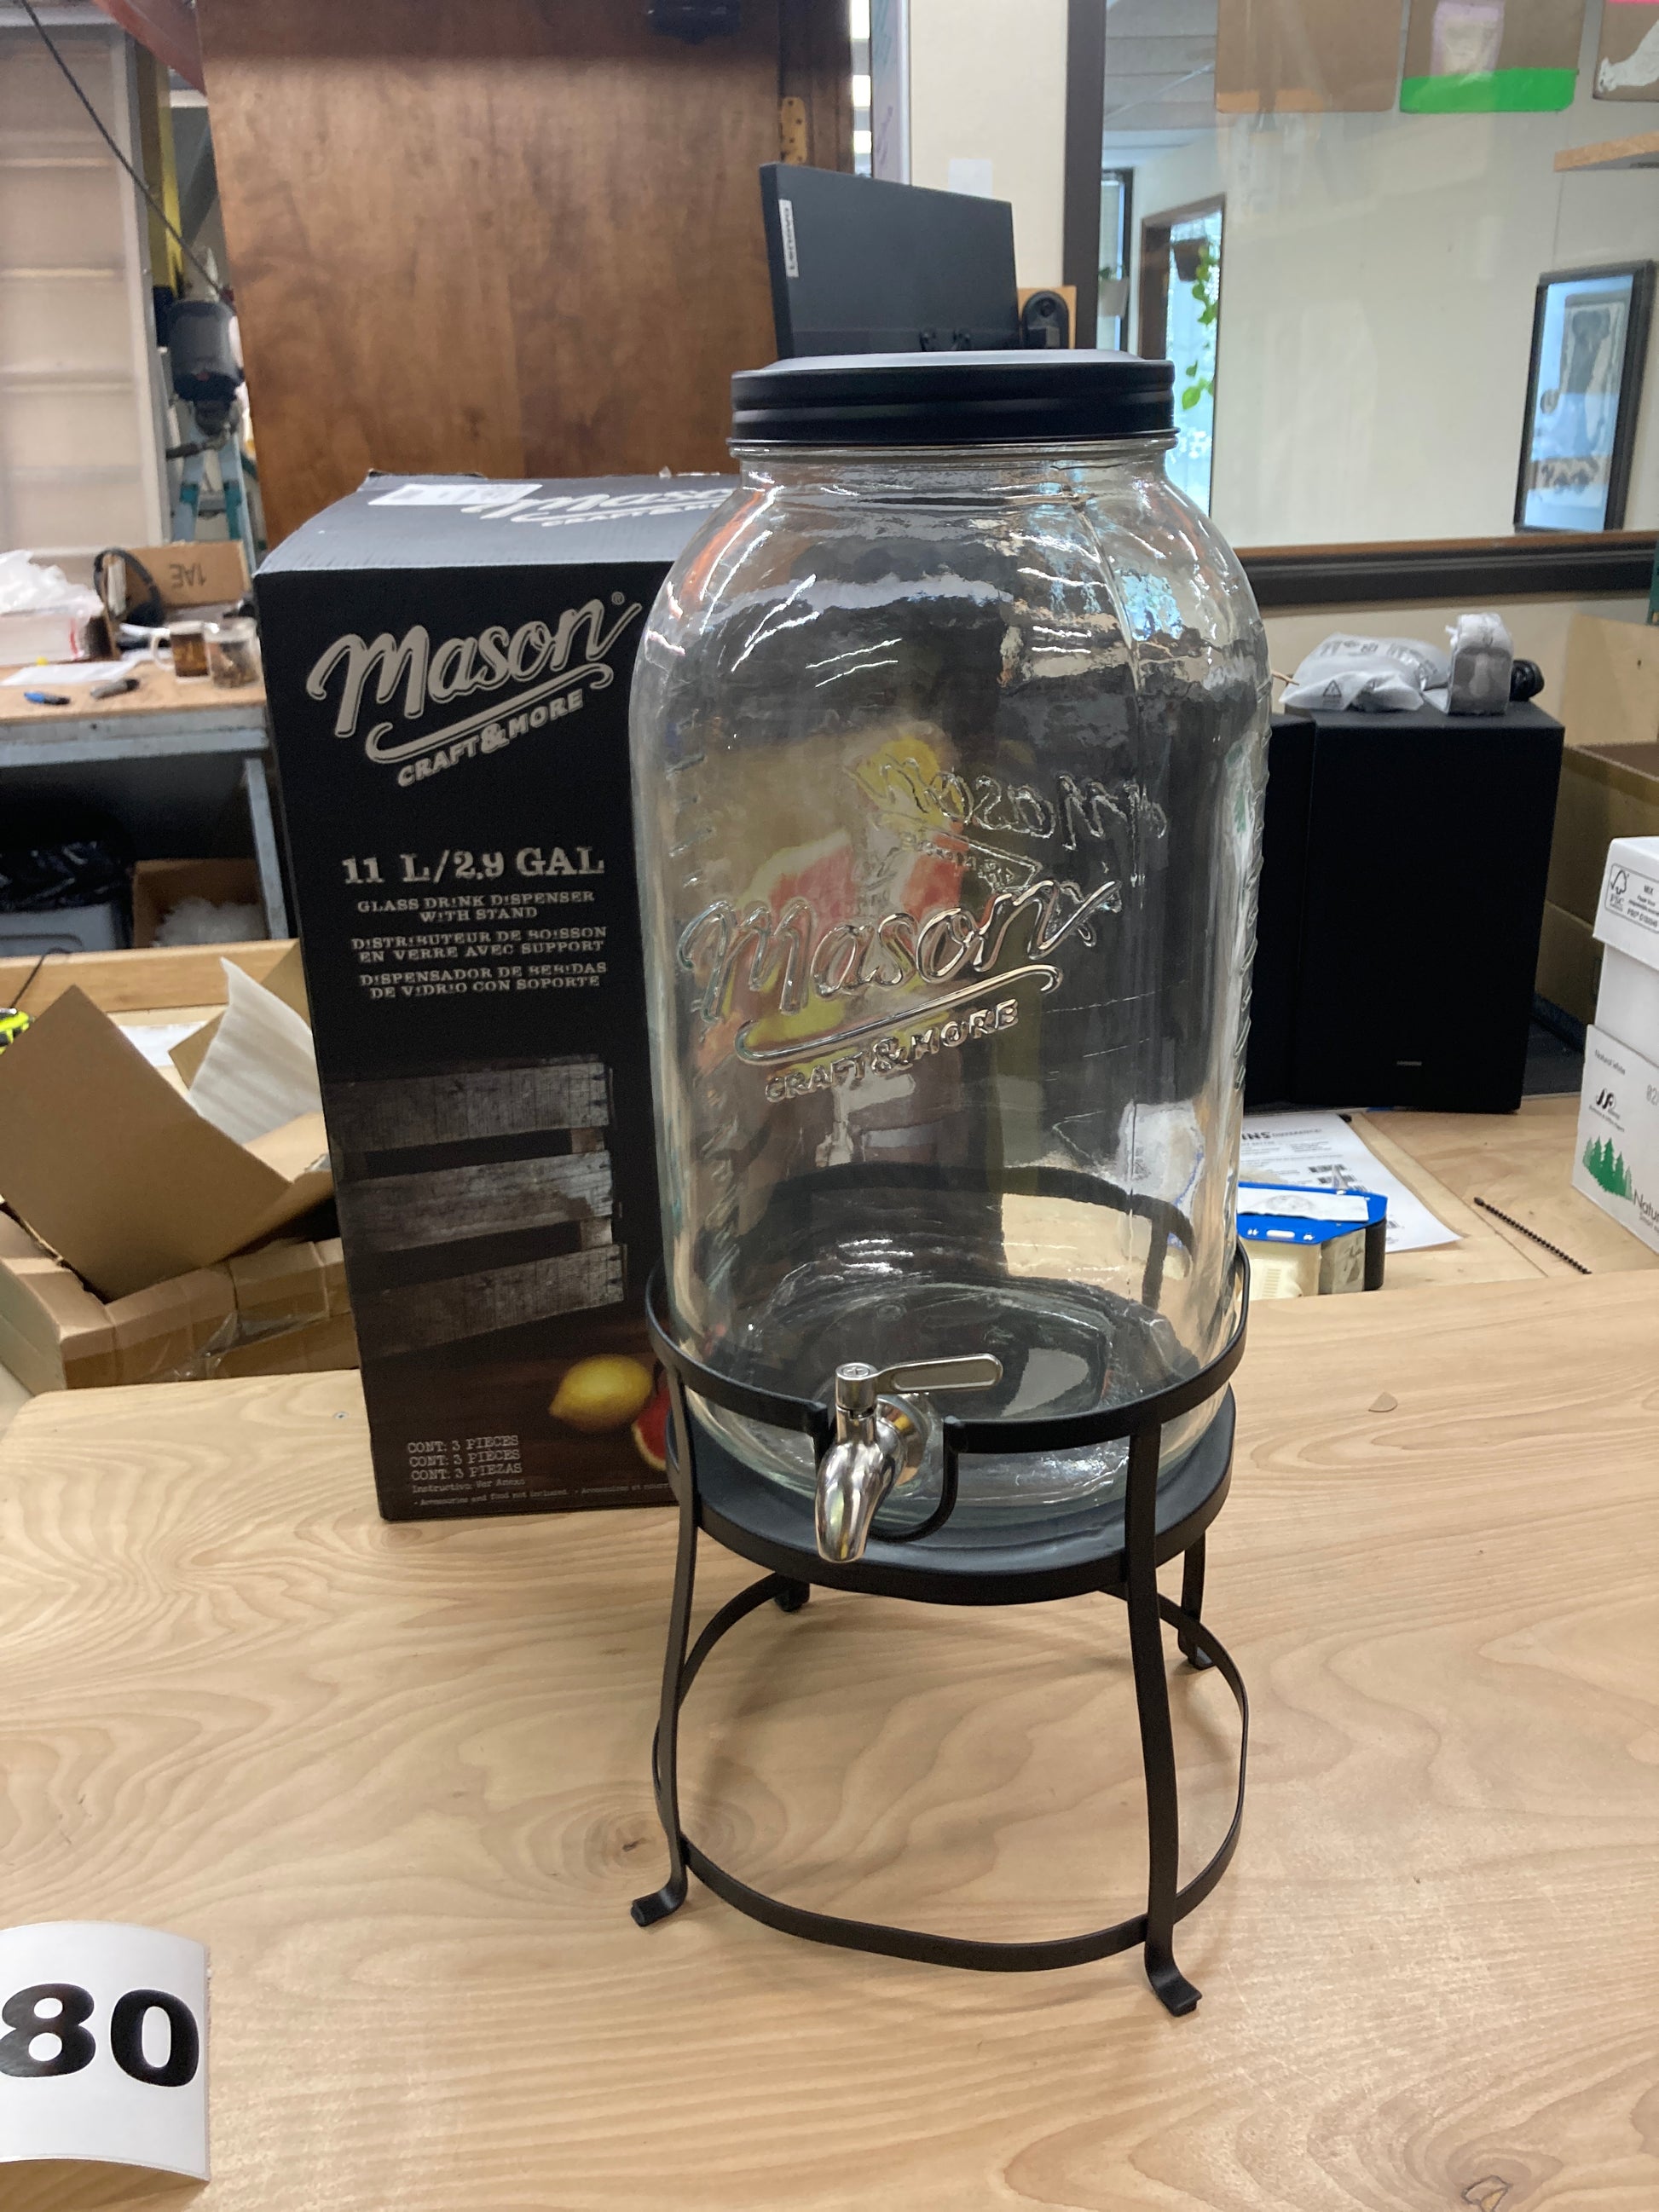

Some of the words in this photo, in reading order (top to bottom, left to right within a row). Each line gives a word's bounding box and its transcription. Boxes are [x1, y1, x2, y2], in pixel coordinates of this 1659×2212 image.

[461, 488, 734, 519] Maso
[397, 688, 585, 787] CRAFT&MORE
[342, 856, 384, 884] 11
[516, 846, 605, 877] GAL
[357, 898, 419, 913] GLASS
[424, 895, 485, 910] DRINK
[490, 891, 595, 907] DISPENSER
[419, 910, 470, 923] WITH
[476, 906, 538, 921] STAND
[351, 932, 492, 950] DISTRIBUTEUR
[495, 930, 522, 943] DE
[528, 927, 607, 941] BOISSON
[359, 950, 385, 963] EN
[392, 946, 459, 961] VERRE
[465, 944, 513, 958] AVEC
[521, 939, 604, 955] SUPPORT
[360, 967, 493, 986] DISPENSADOR
[497, 965, 523, 979] DE
[529, 962, 607, 976] BEBIDAS
[369, 986, 396, 1000] DE
[401, 982, 468, 998] VIDRIO
[472, 979, 511, 992] CON
[516, 975, 600, 990] SOPORTE
[765, 997, 1020, 1104] CRAFT&MORE
[408, 1441, 448, 1453] CONT:
[452, 1440, 461, 1451] 3
[466, 1435, 519, 1450] PIECES
[409, 1454, 449, 1467] CONT:
[454, 1453, 463, 1465] 3
[455, 1468, 465, 1479] 3
[470, 1462, 523, 1477] PIEZAS
